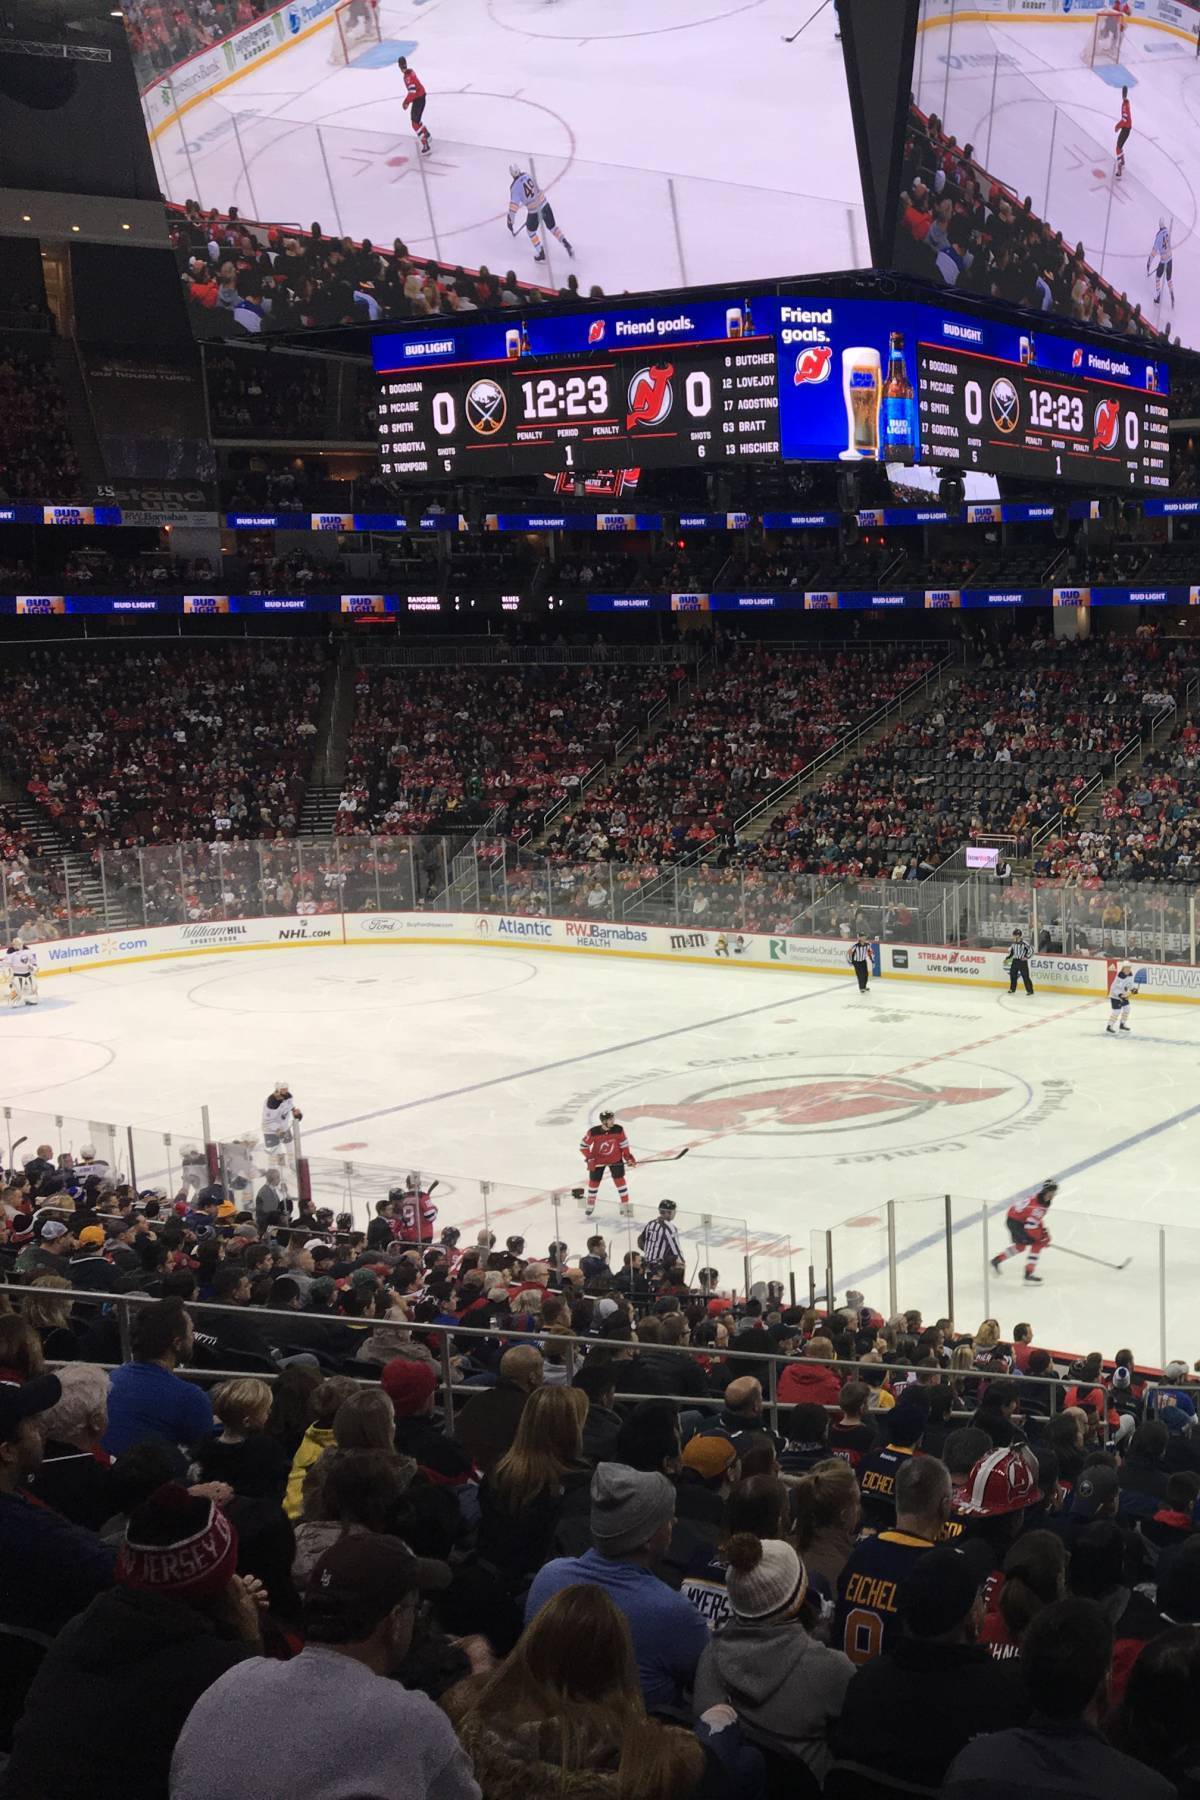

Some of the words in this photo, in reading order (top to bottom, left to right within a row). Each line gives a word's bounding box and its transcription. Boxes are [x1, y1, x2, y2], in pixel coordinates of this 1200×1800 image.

[781, 307, 832, 324] Friend
[616, 318, 654, 336] Friend
[657, 316, 695, 335] goals.
[943, 323, 959, 336] BUD
[960, 328, 981, 341] LIGHT
[781, 327, 831, 344] goals.
[406, 343, 425, 356] BUD
[425, 341, 452, 354] LIGHT
[735, 353, 775, 366] BUTCHER
[1088, 354, 1110, 371] Friend
[1111, 362, 1131, 376] goals.
[736, 375, 775, 388] LOVEJOY
[521, 374, 608, 419] 12:23
[685, 371, 712, 417] 0
[390, 402, 419, 413] MCCABE
[737, 397, 779, 410] AGOSTINO
[964, 380, 983, 425] 0
[432, 392, 456, 435] 0
[1029, 389, 1084, 432] 12:23
[392, 422, 413, 433] SMITH
[557, 428, 579, 438] PERIOD
[593, 425, 620, 436] PENALTY
[739, 420, 767, 432] BRATT
[1125, 411, 1139, 450] 0
[517, 431, 543, 441] PENALTY
[393, 441, 426, 452] SOBOTKA
[698, 445, 705, 458] 6
[740, 441, 779, 454] HISCHIER
[565, 445, 574, 466] 1
[972, 451, 978, 463] 5
[444, 460, 451, 472] 5
[1056, 455, 1062, 475] 1
[179, 925, 227, 939] William
[227, 925, 247, 935] HILL
[368, 920, 394, 931] Ford
[498, 917, 552, 937] Atlantic
[566, 922, 648, 942] RWJBarnabas
[278, 929, 331, 940] NHL.COM
[48, 943, 99, 960] Walmart
[118, 938, 148, 951] com
[577, 938, 611, 948] HEALTH
[918, 952, 948, 962] STREAM
[959, 955, 986, 965] GAMES
[926, 964, 943, 973] LIVE
[943, 966, 953, 974] ON
[954, 966, 968, 975] MSG
[969, 967, 979, 976] GO
[1030, 959, 1054, 971] EAST
[1056, 961, 1090, 973] COAST
[1031, 970, 1061, 981] POWER
[1062, 972, 1071, 982] &
[1071, 973, 1090, 984] GAS
[862, 1471, 896, 1495] EICHEL
[143, 1531, 219, 1583] JERSEY
[845, 1573, 898, 1613] EICHEL
